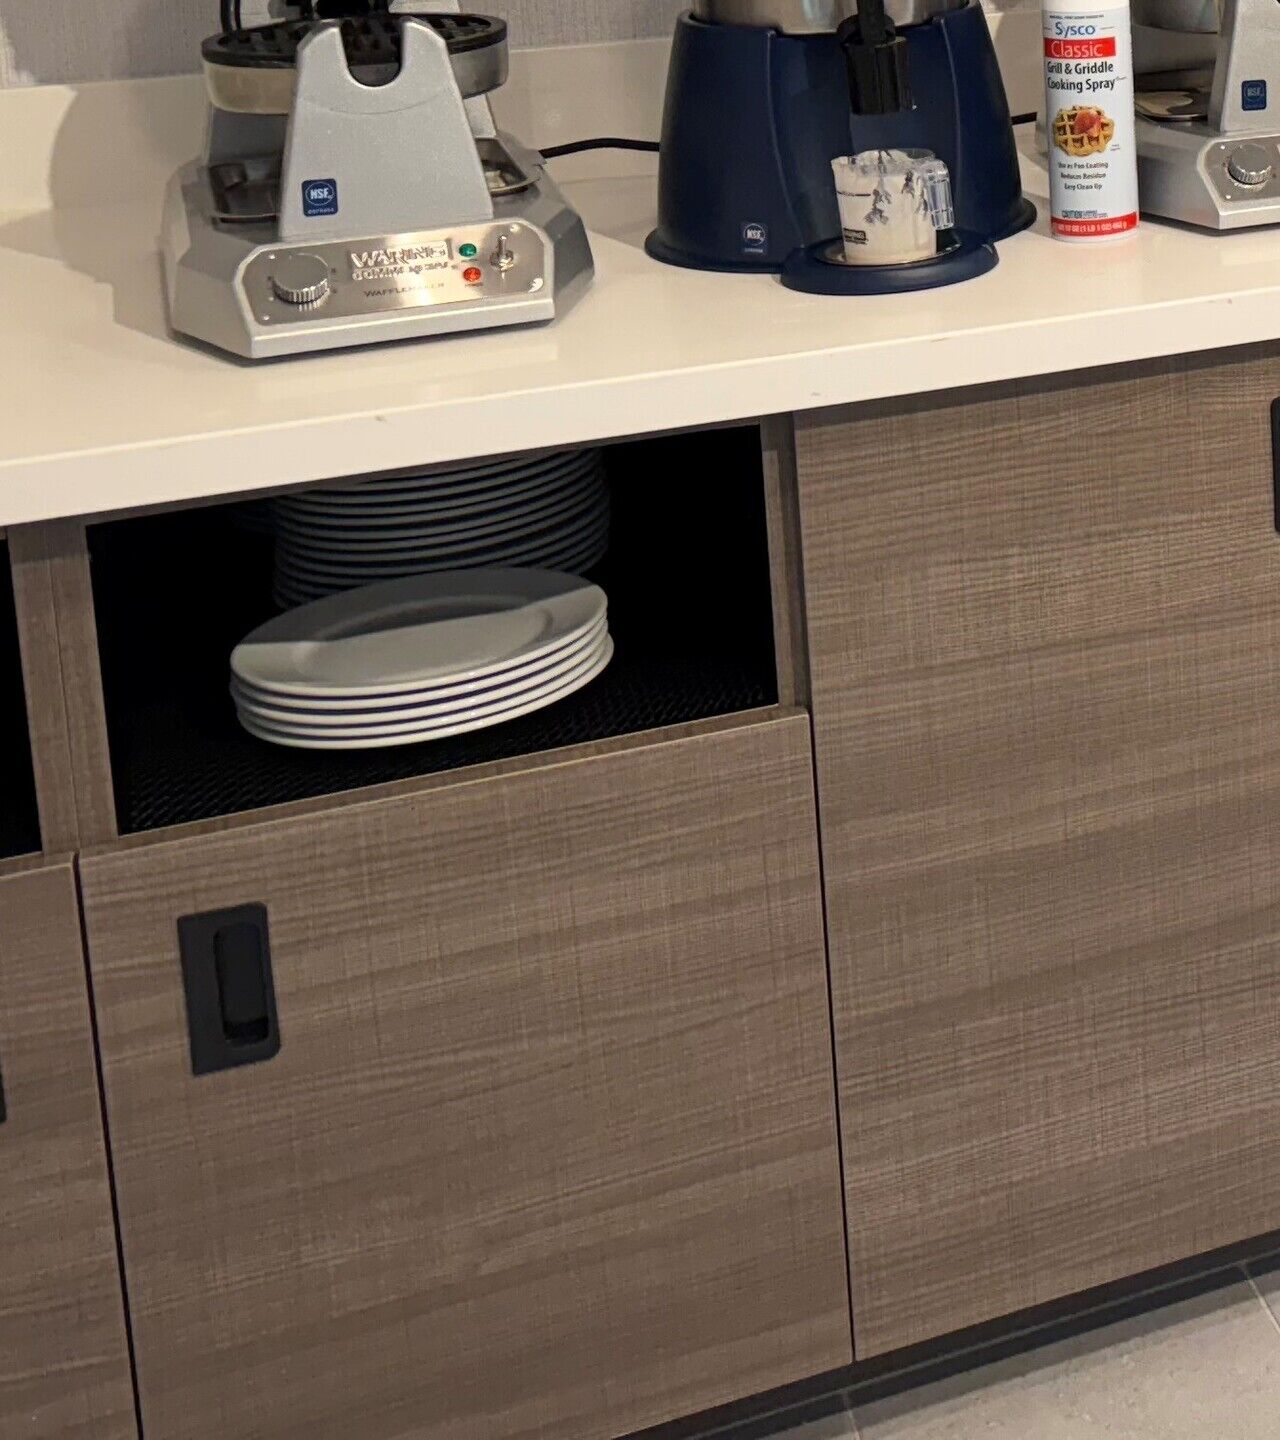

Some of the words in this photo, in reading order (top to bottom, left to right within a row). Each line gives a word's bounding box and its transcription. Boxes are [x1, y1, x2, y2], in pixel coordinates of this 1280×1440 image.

[1055, 21, 1096, 38] Sysco
[1051, 41, 1104, 58] Classic
[1047, 61, 1063, 74] Grill
[1064, 63, 1073, 75] &
[1074, 61, 1114, 75] Griddle
[1047, 77, 1083, 93] Cooking
[1085, 78, 1115, 92] Spray
[310, 187, 330, 199] NSF
